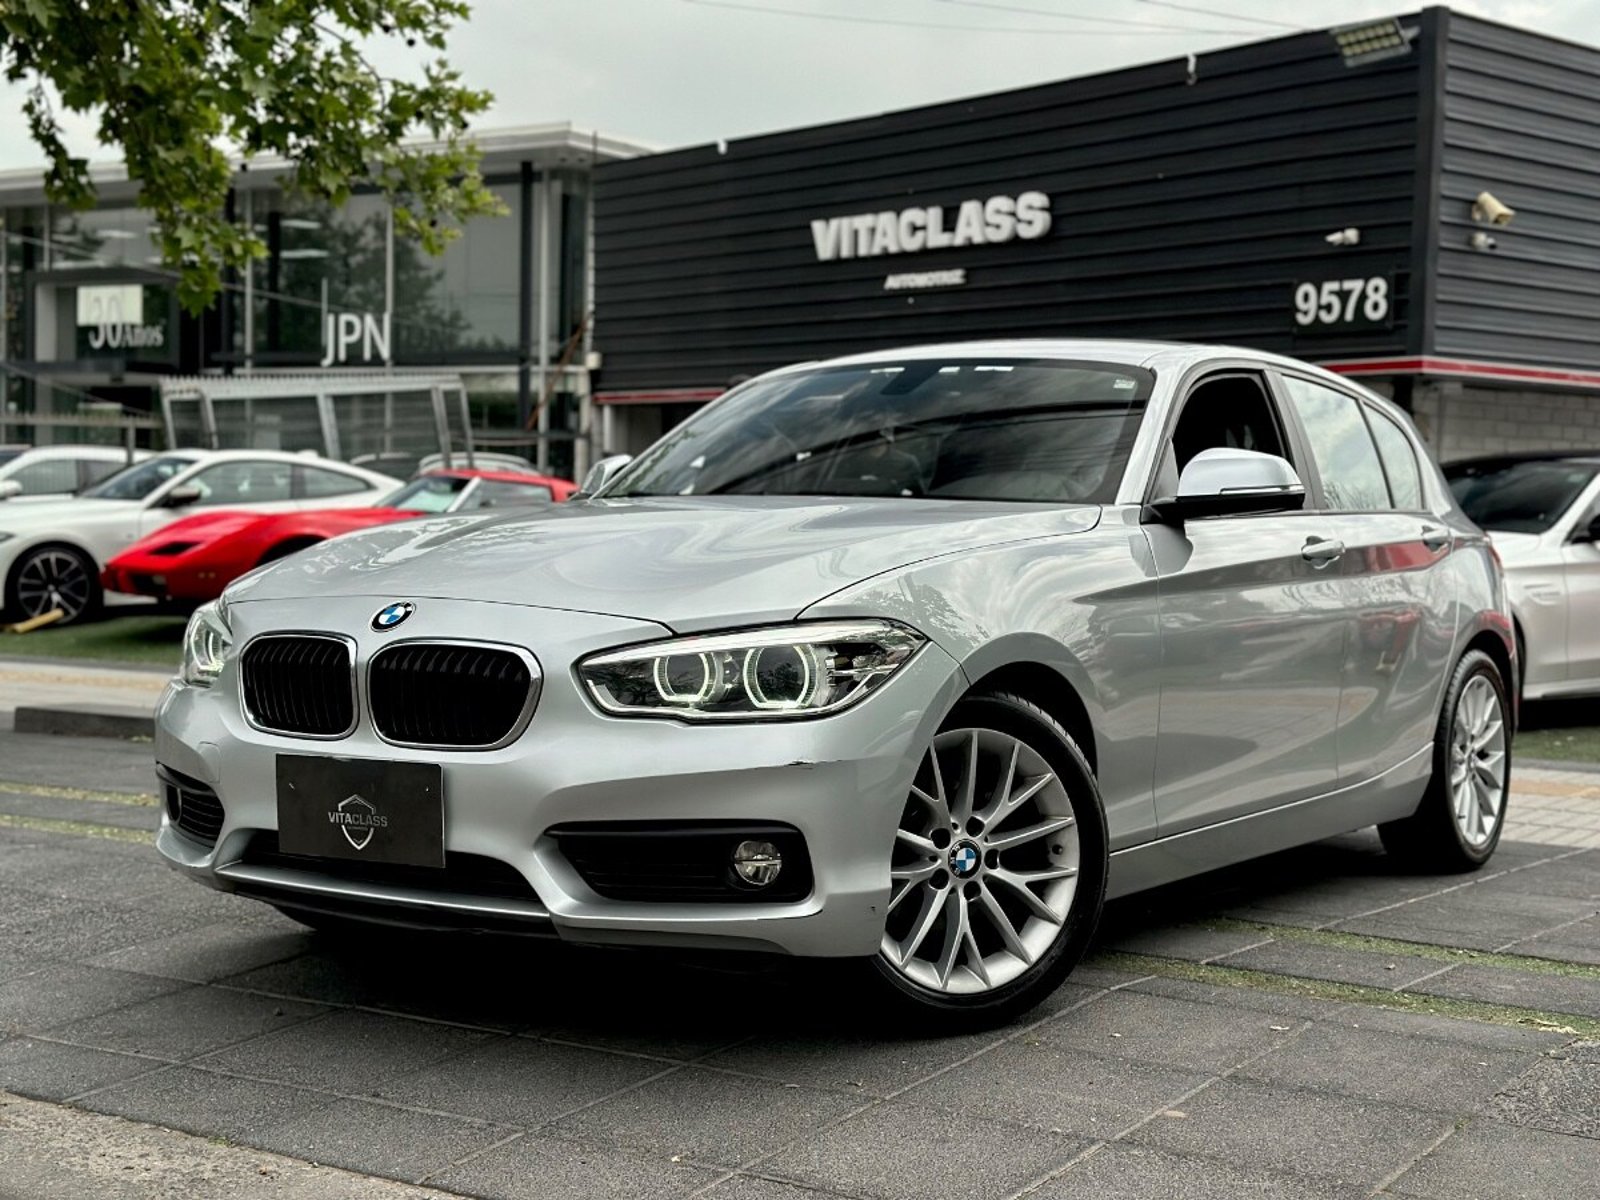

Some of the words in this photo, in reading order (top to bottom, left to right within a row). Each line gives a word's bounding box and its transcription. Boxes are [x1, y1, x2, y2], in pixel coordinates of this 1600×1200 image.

[811, 190, 1052, 261] VITACLASS
[1294, 276, 1389, 326] 9578
[320, 312, 392, 367] JPN
[328, 811, 388, 827] VITACLASS
